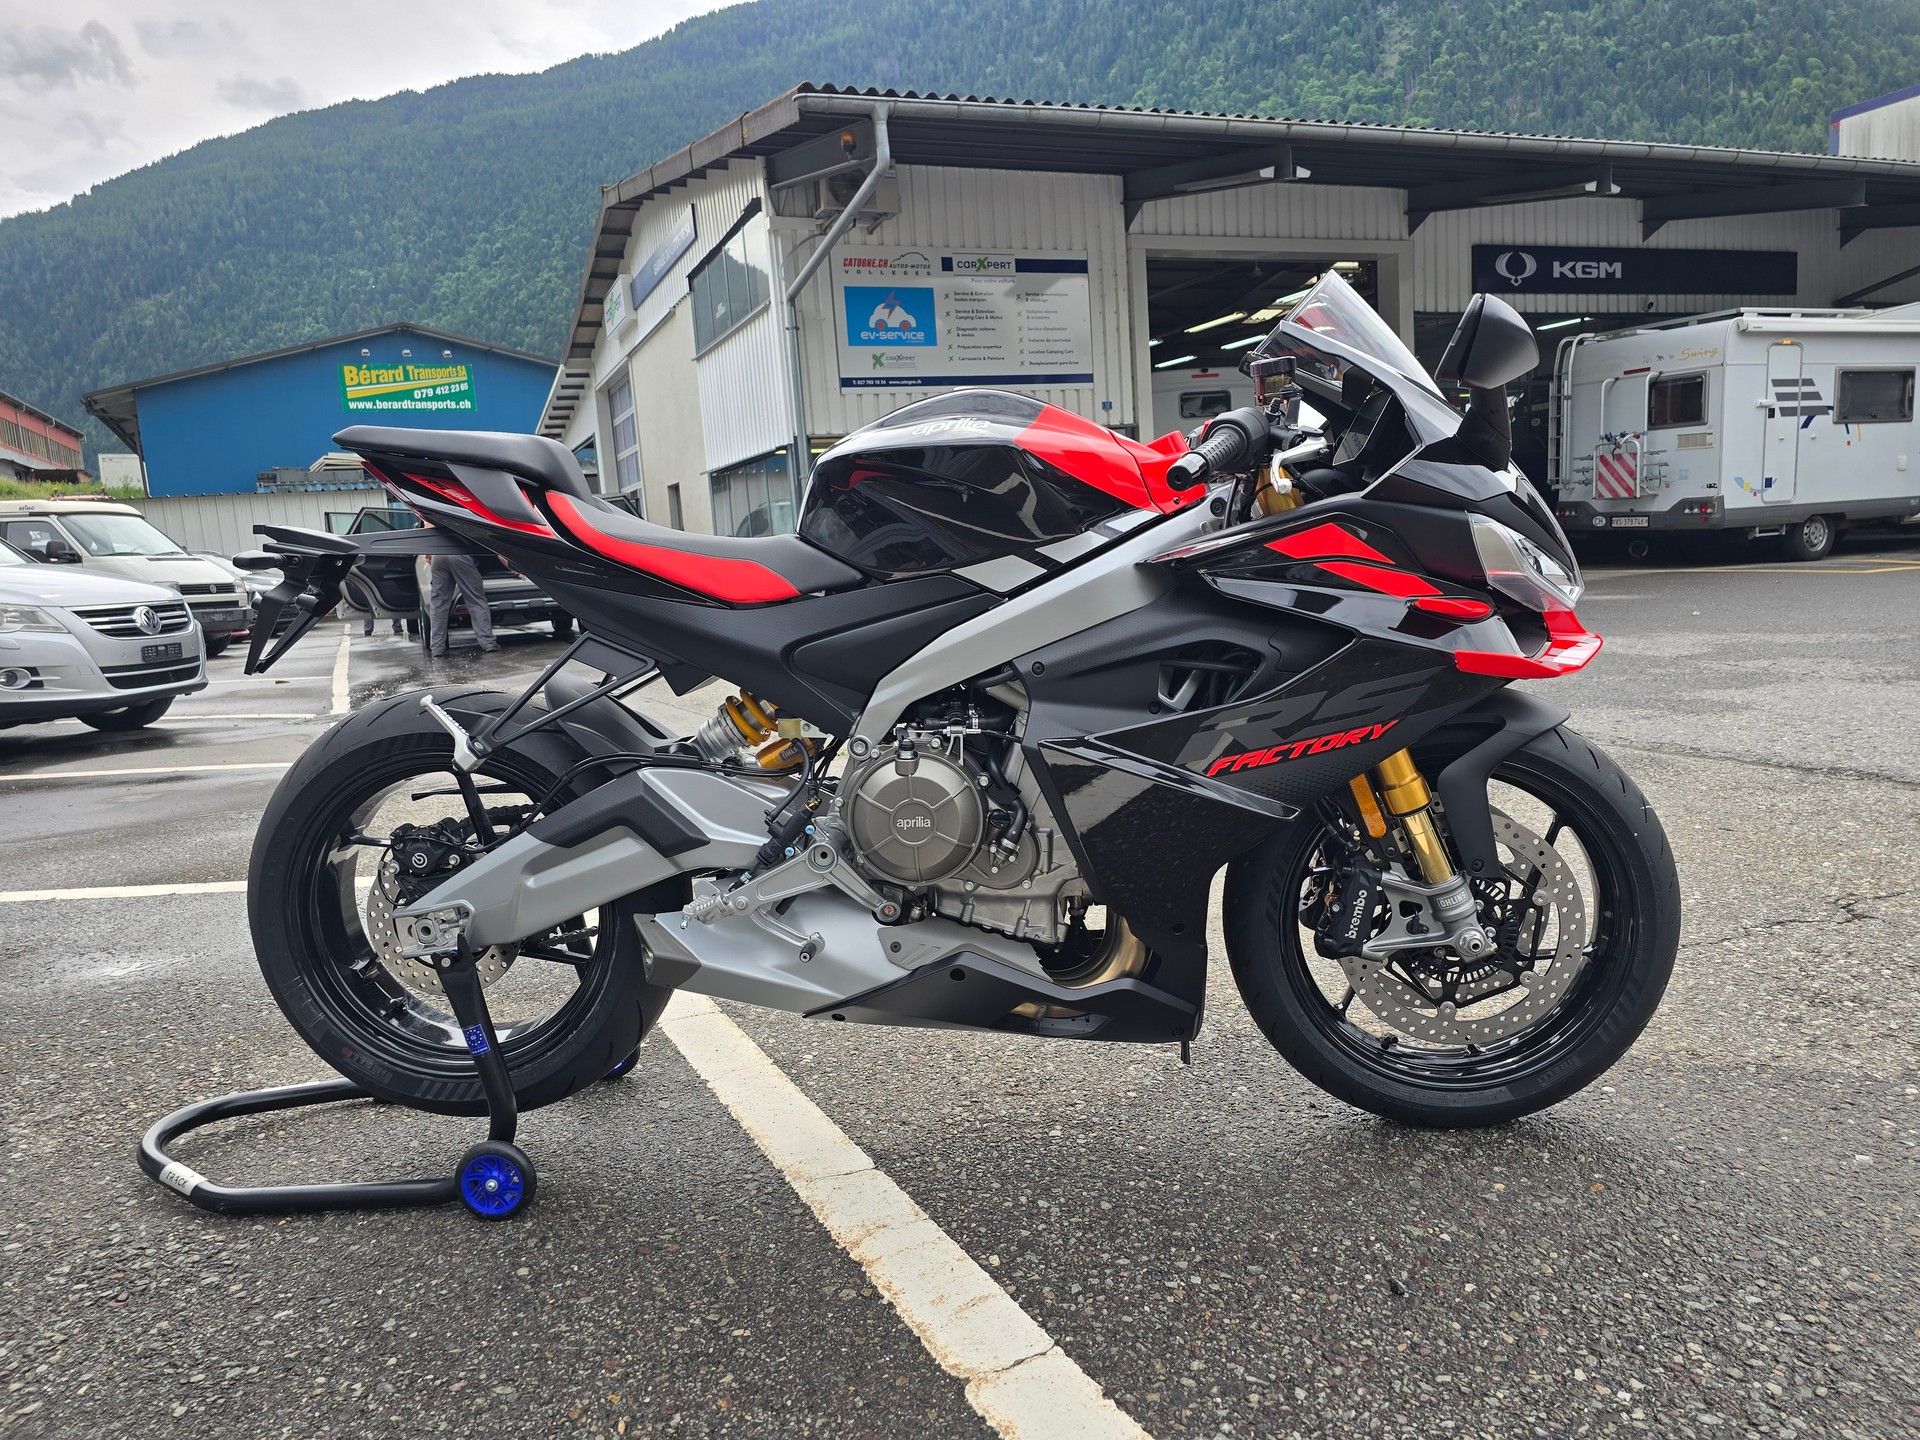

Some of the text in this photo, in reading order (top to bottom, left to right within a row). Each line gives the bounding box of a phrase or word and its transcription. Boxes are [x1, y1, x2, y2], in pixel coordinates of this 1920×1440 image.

[843, 258, 889, 268] CATOGNE.CH
[1552, 261, 1622, 278] KGM
[860, 331, 925, 340] ev-service
[1677, 347, 1719, 361] Swing
[343, 364, 467, 386] Bérard Transports SA
[413, 388, 434, 400] 079
[435, 386, 450, 395] 412
[450, 384, 460, 393] 23
[348, 399, 472, 411] www.berardtransports.ch
[911, 417, 992, 436] aprilia
[1594, 517, 1604, 526] CH
[1173, 665, 1449, 772] RS
[1206, 719, 1399, 777] FACTORY
[896, 816, 931, 831] aprilia
[1344, 889, 1368, 939] brembo
